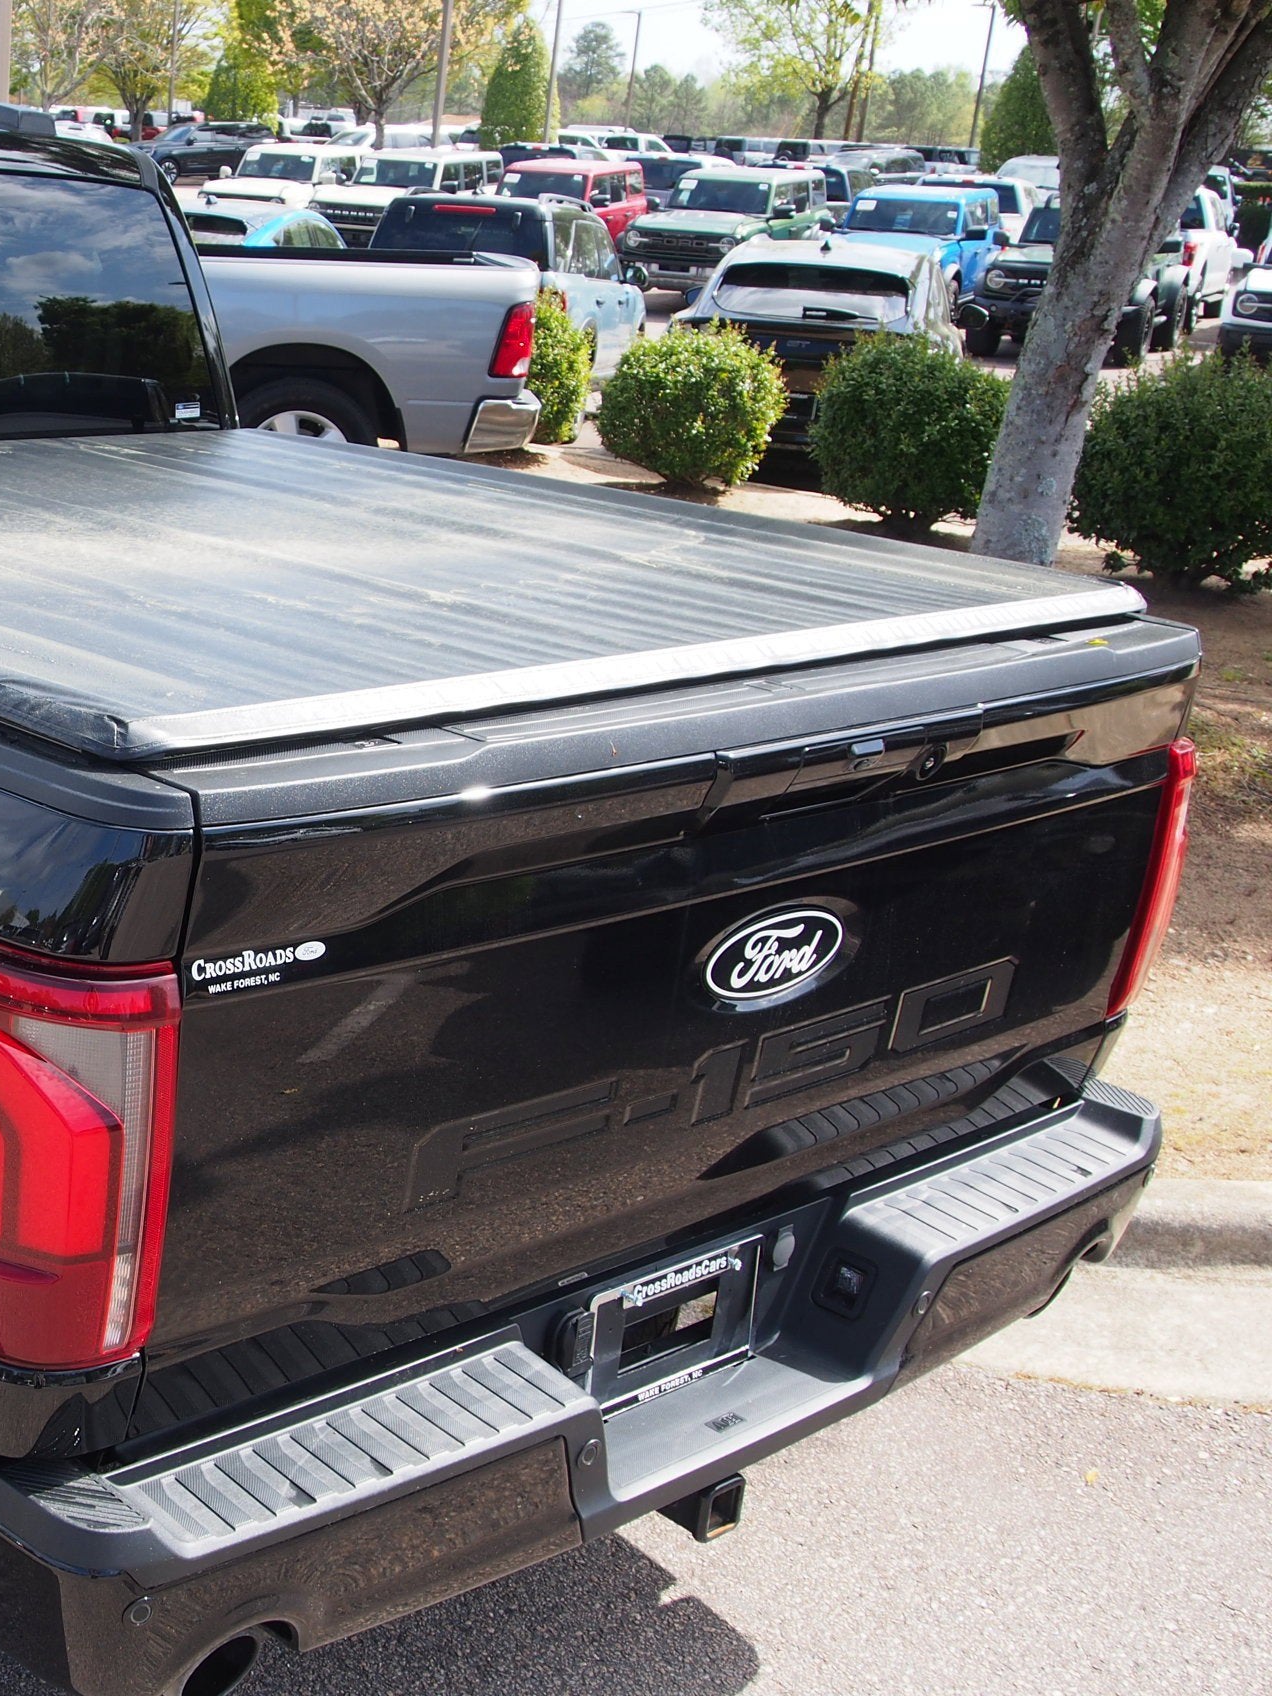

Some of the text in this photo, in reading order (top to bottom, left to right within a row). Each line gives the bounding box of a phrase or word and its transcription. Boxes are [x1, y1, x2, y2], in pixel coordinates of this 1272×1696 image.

[207, 972, 281, 995] WAKE FOREST, NC
[406, 955, 1018, 1212] F-150
[633, 1255, 727, 1299] CrossRoadsCars
[637, 1369, 704, 1402] WAKE FOREST, NC
